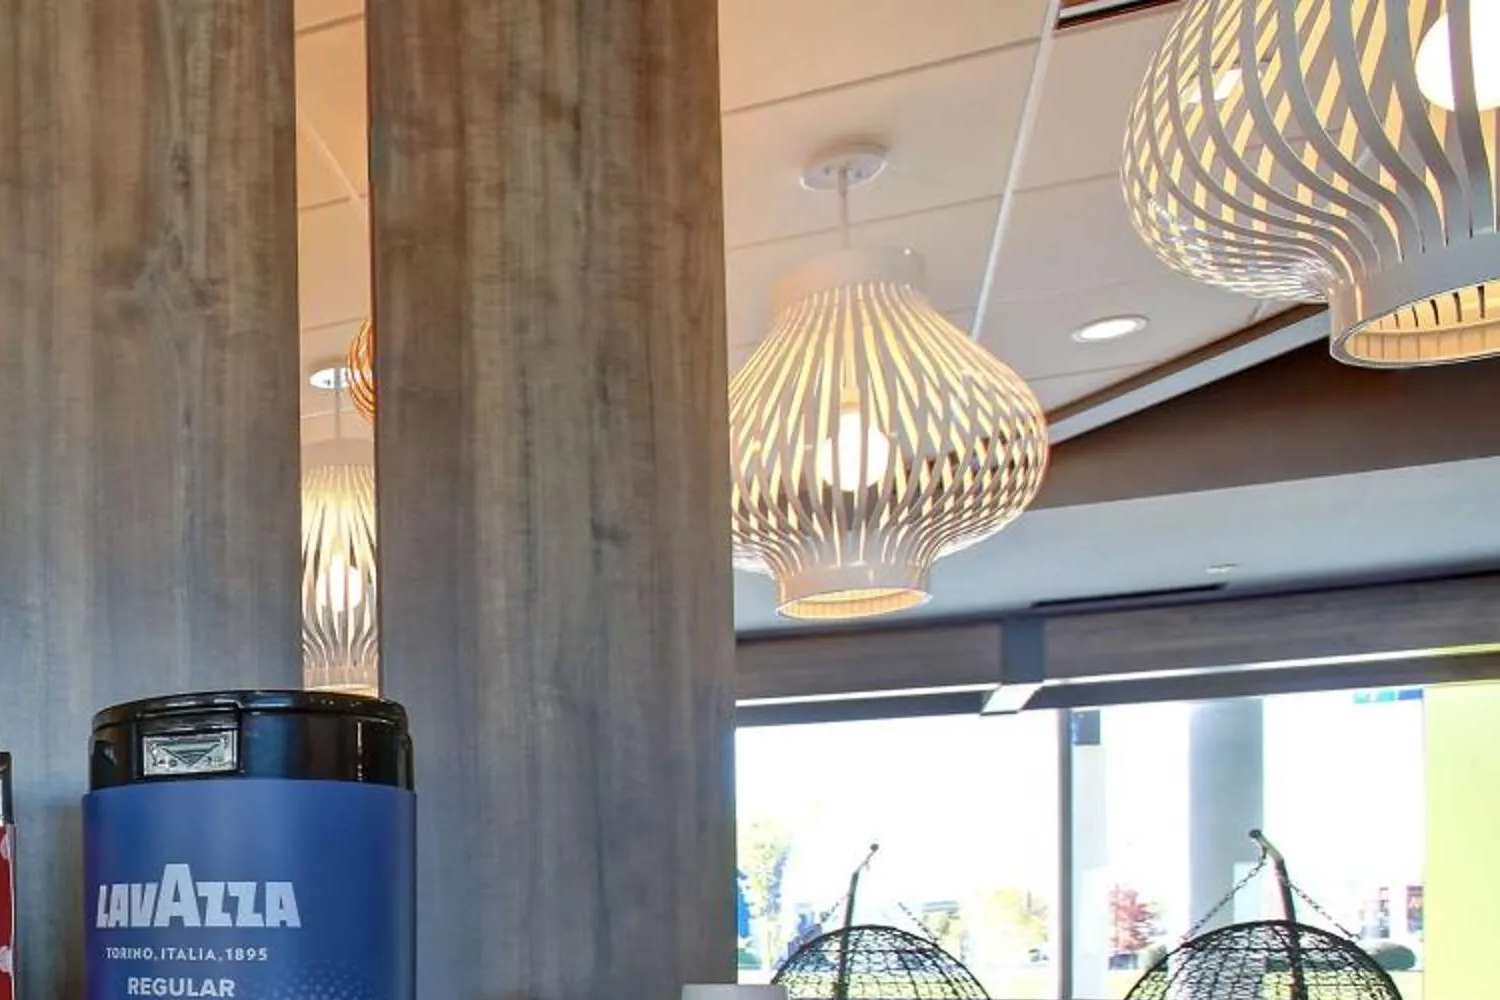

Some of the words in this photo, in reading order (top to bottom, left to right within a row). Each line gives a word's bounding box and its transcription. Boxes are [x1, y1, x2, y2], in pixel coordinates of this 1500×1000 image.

[95, 863, 301, 929] LAVAZZA
[225, 946, 268, 962] 1895
[126, 975, 236, 998] REGULAR
